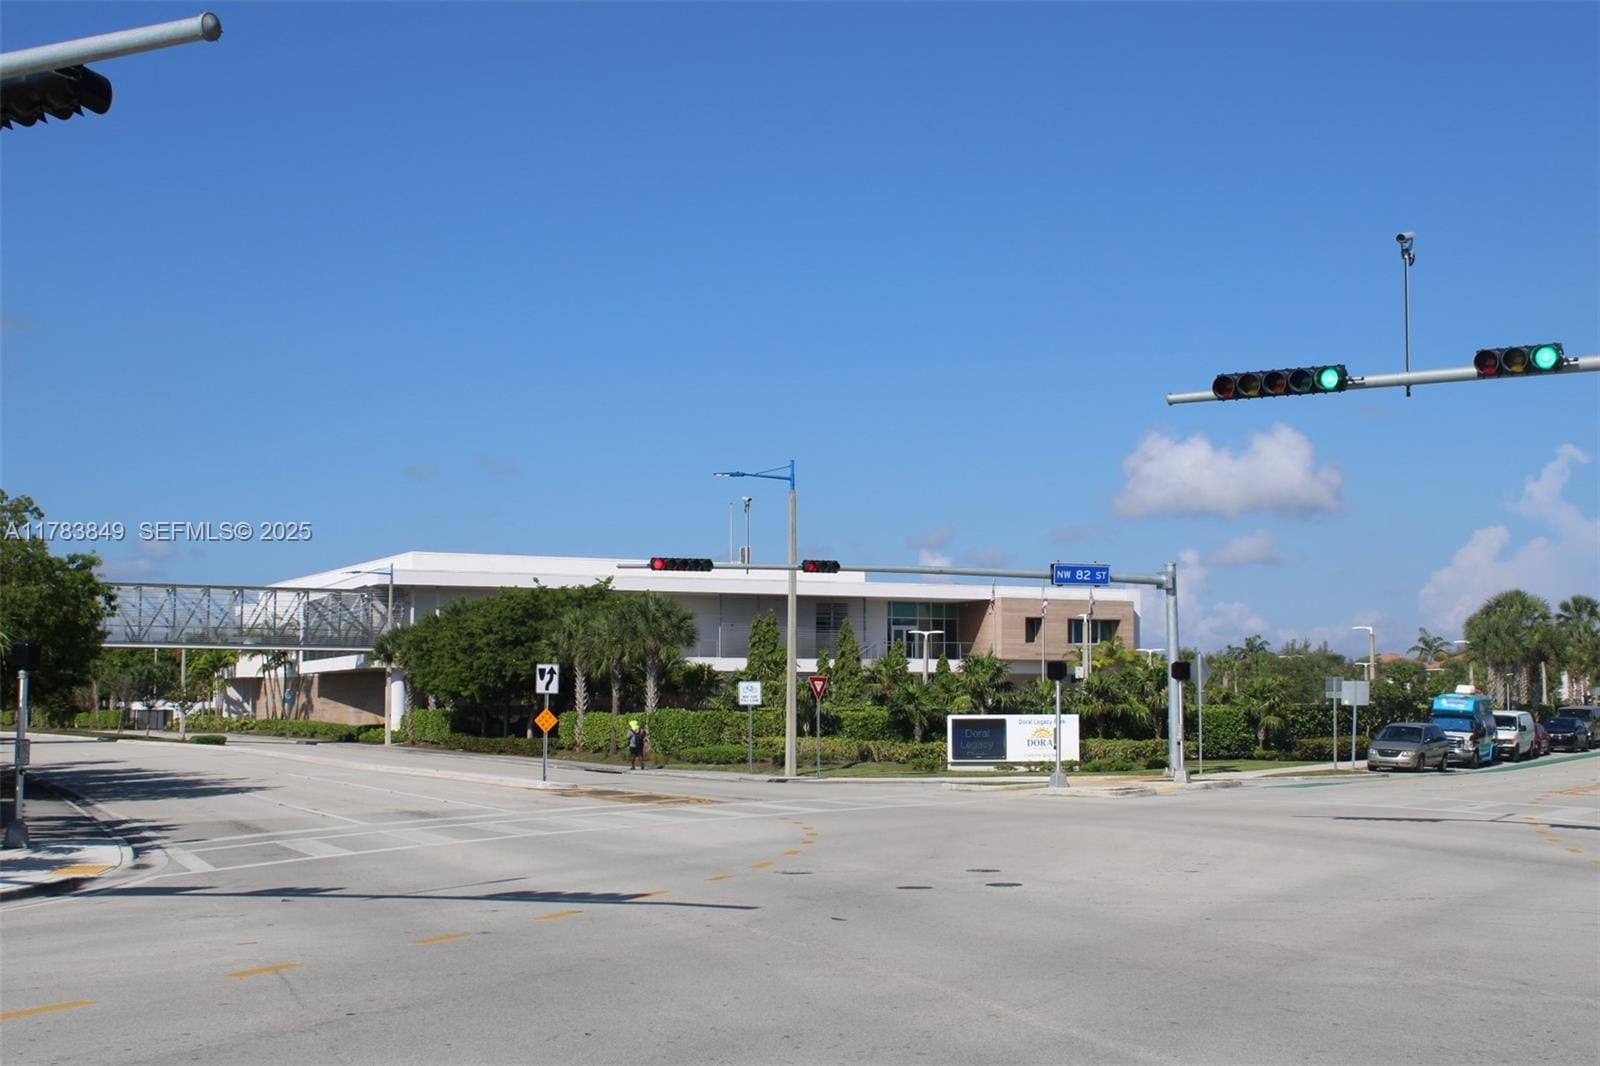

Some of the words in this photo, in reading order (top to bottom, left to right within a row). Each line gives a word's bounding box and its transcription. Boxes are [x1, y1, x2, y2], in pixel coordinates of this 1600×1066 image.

[1057, 570, 1071, 579] NW
[1076, 570, 1091, 580] 82
[1095, 571, 1107, 580] ST
[964, 729, 990, 738] Doral
